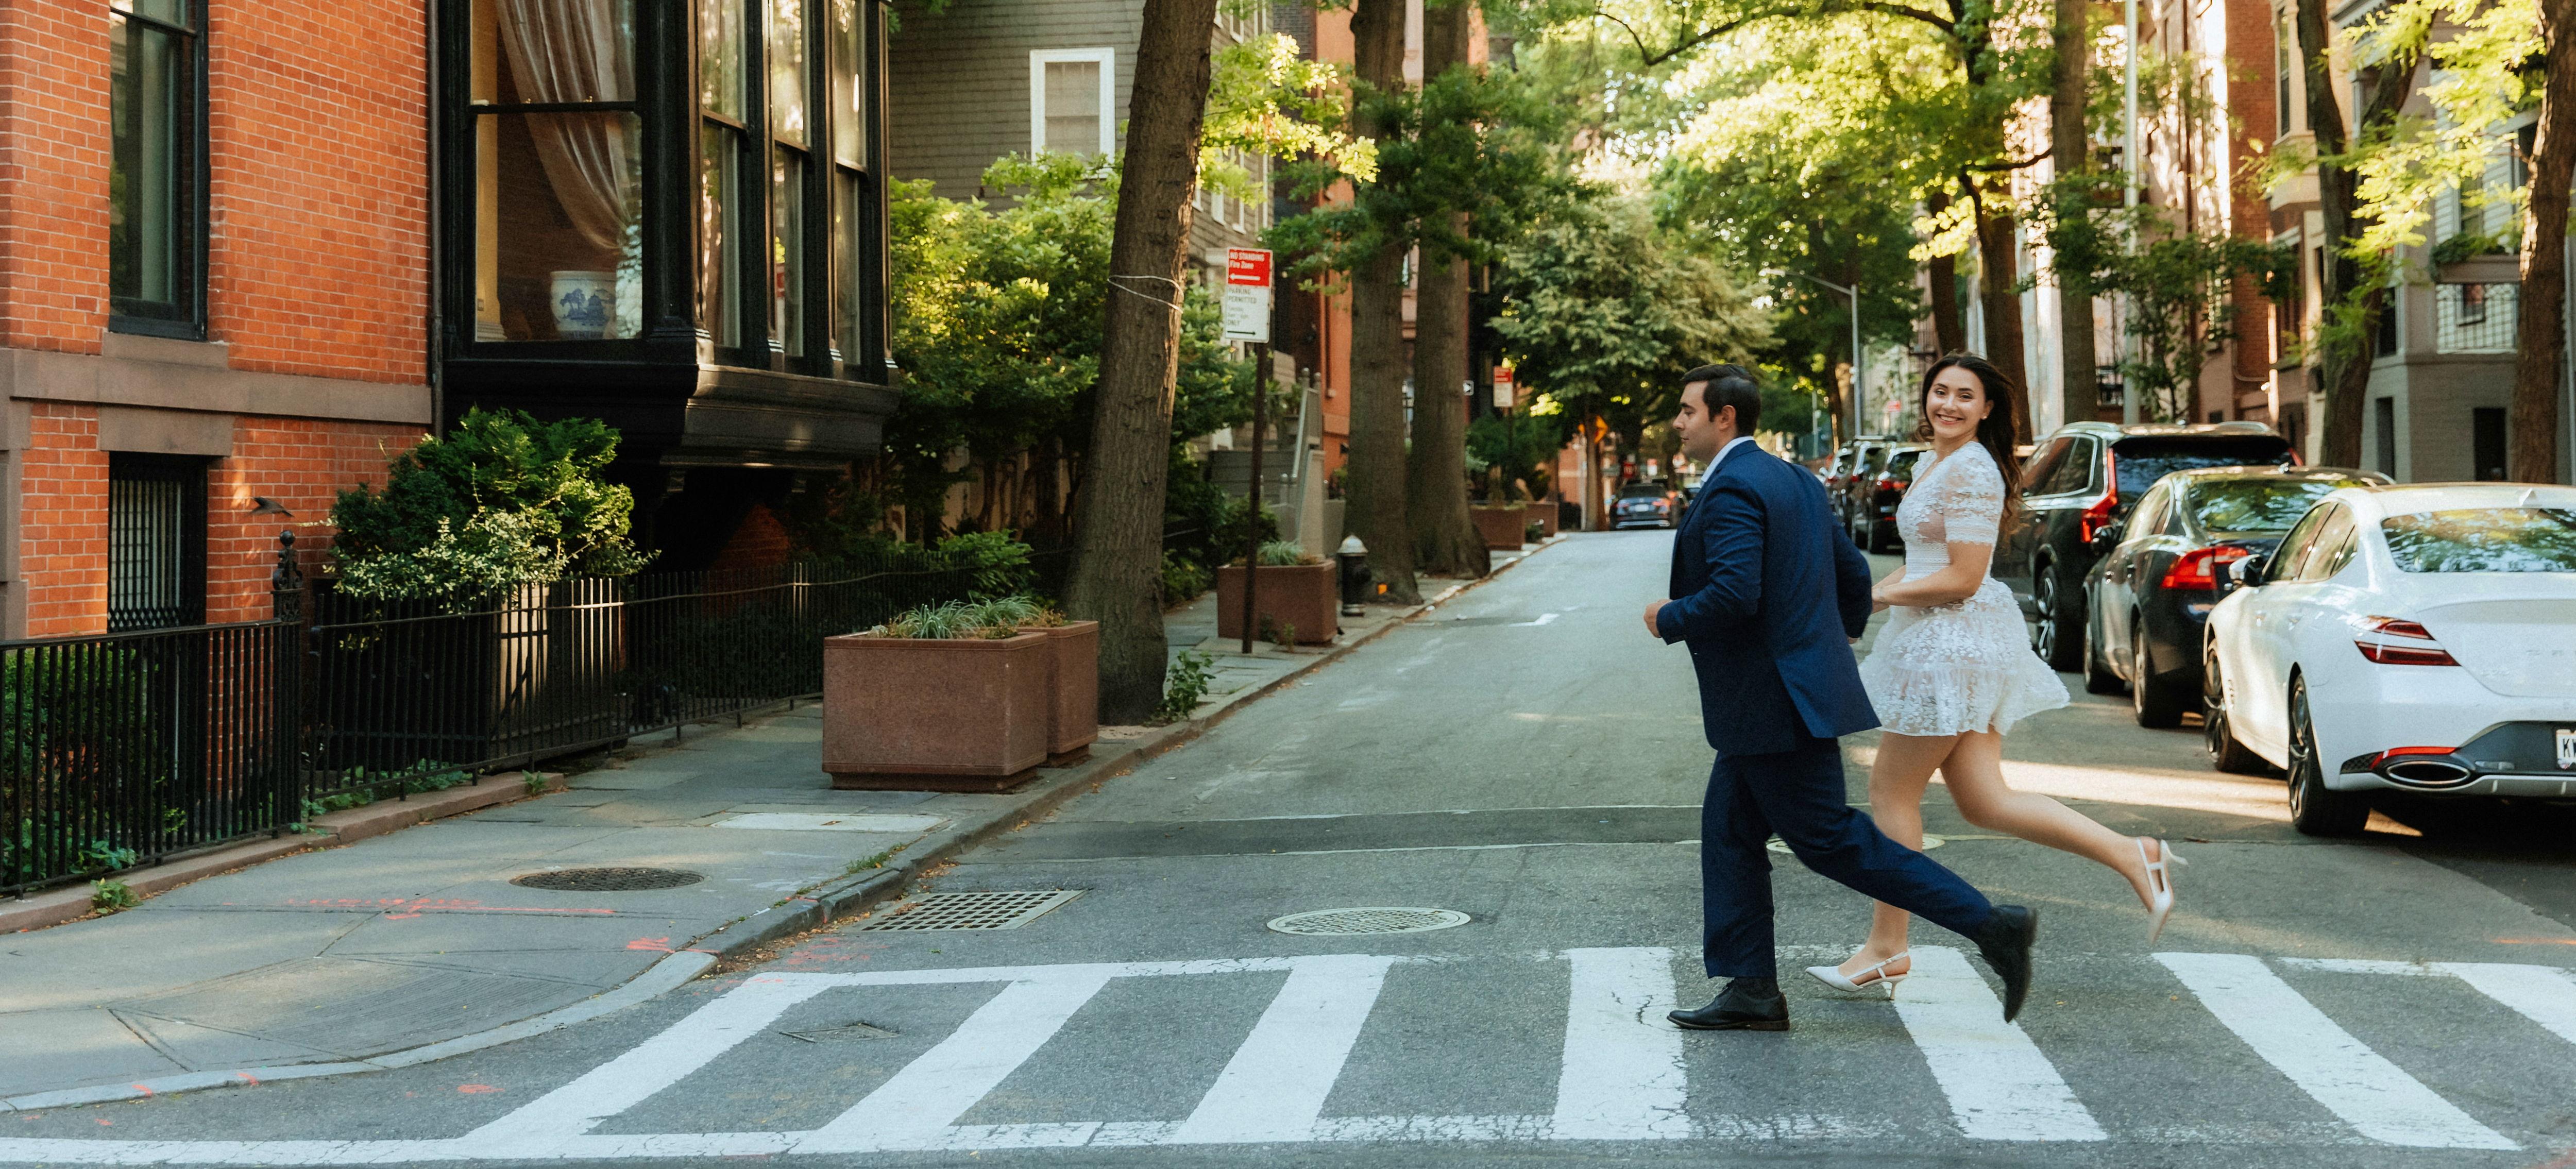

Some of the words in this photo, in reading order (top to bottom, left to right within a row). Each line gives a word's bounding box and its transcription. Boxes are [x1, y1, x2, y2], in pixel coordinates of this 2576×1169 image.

[1229, 251, 1238, 260] NO
[1238, 252, 1265, 262] STANDING
[1229, 260, 1241, 268] Fire
[1241, 261, 1255, 269] Zone
[1228, 296, 1257, 304] PERMITTED
